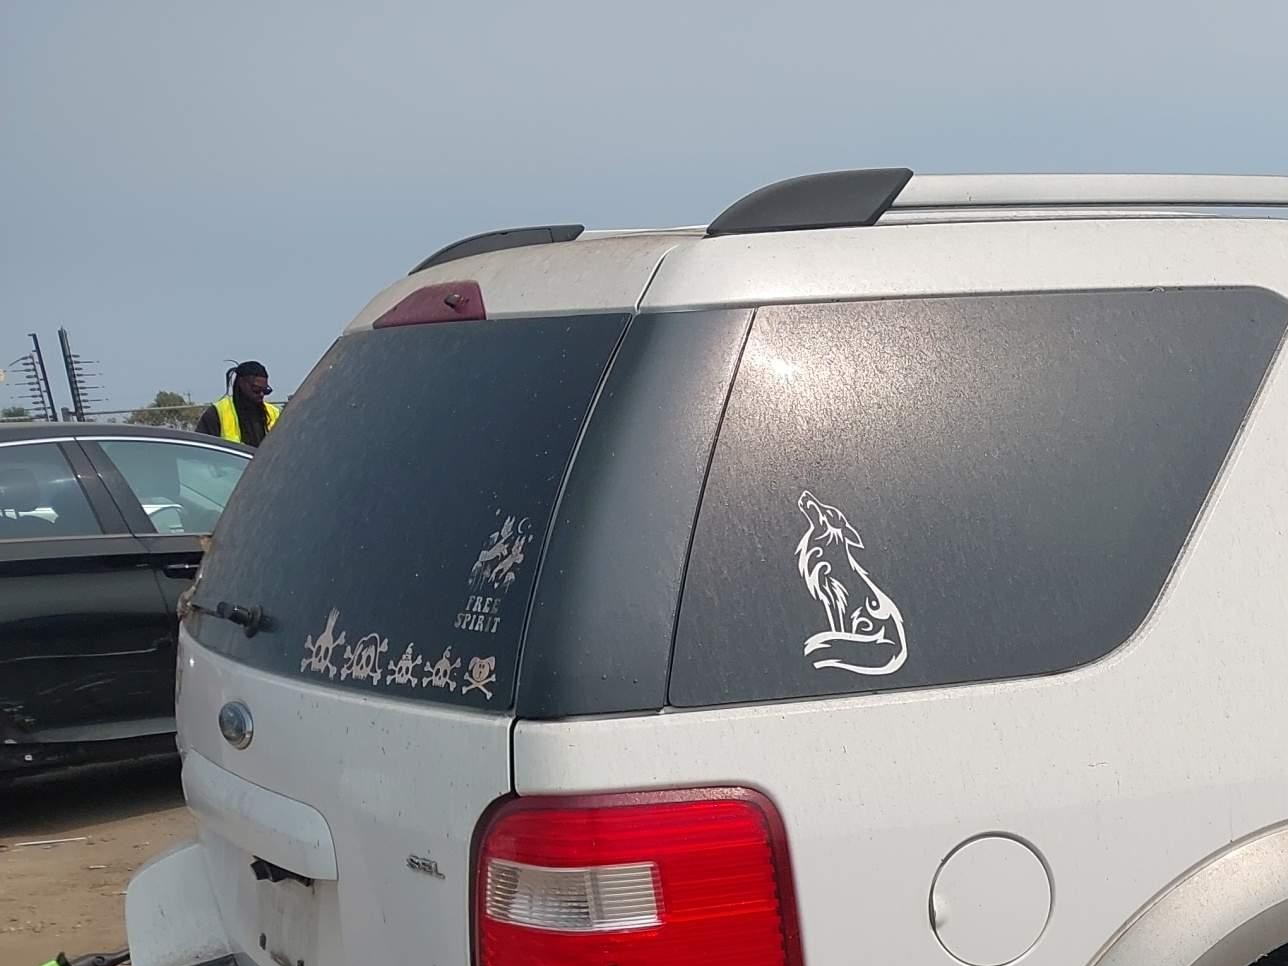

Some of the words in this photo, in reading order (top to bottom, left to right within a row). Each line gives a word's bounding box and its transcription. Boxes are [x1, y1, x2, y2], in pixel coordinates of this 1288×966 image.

[465, 595, 501, 614] FREE
[454, 612, 501, 633] SPIRIT
[405, 855, 446, 880] SEL
